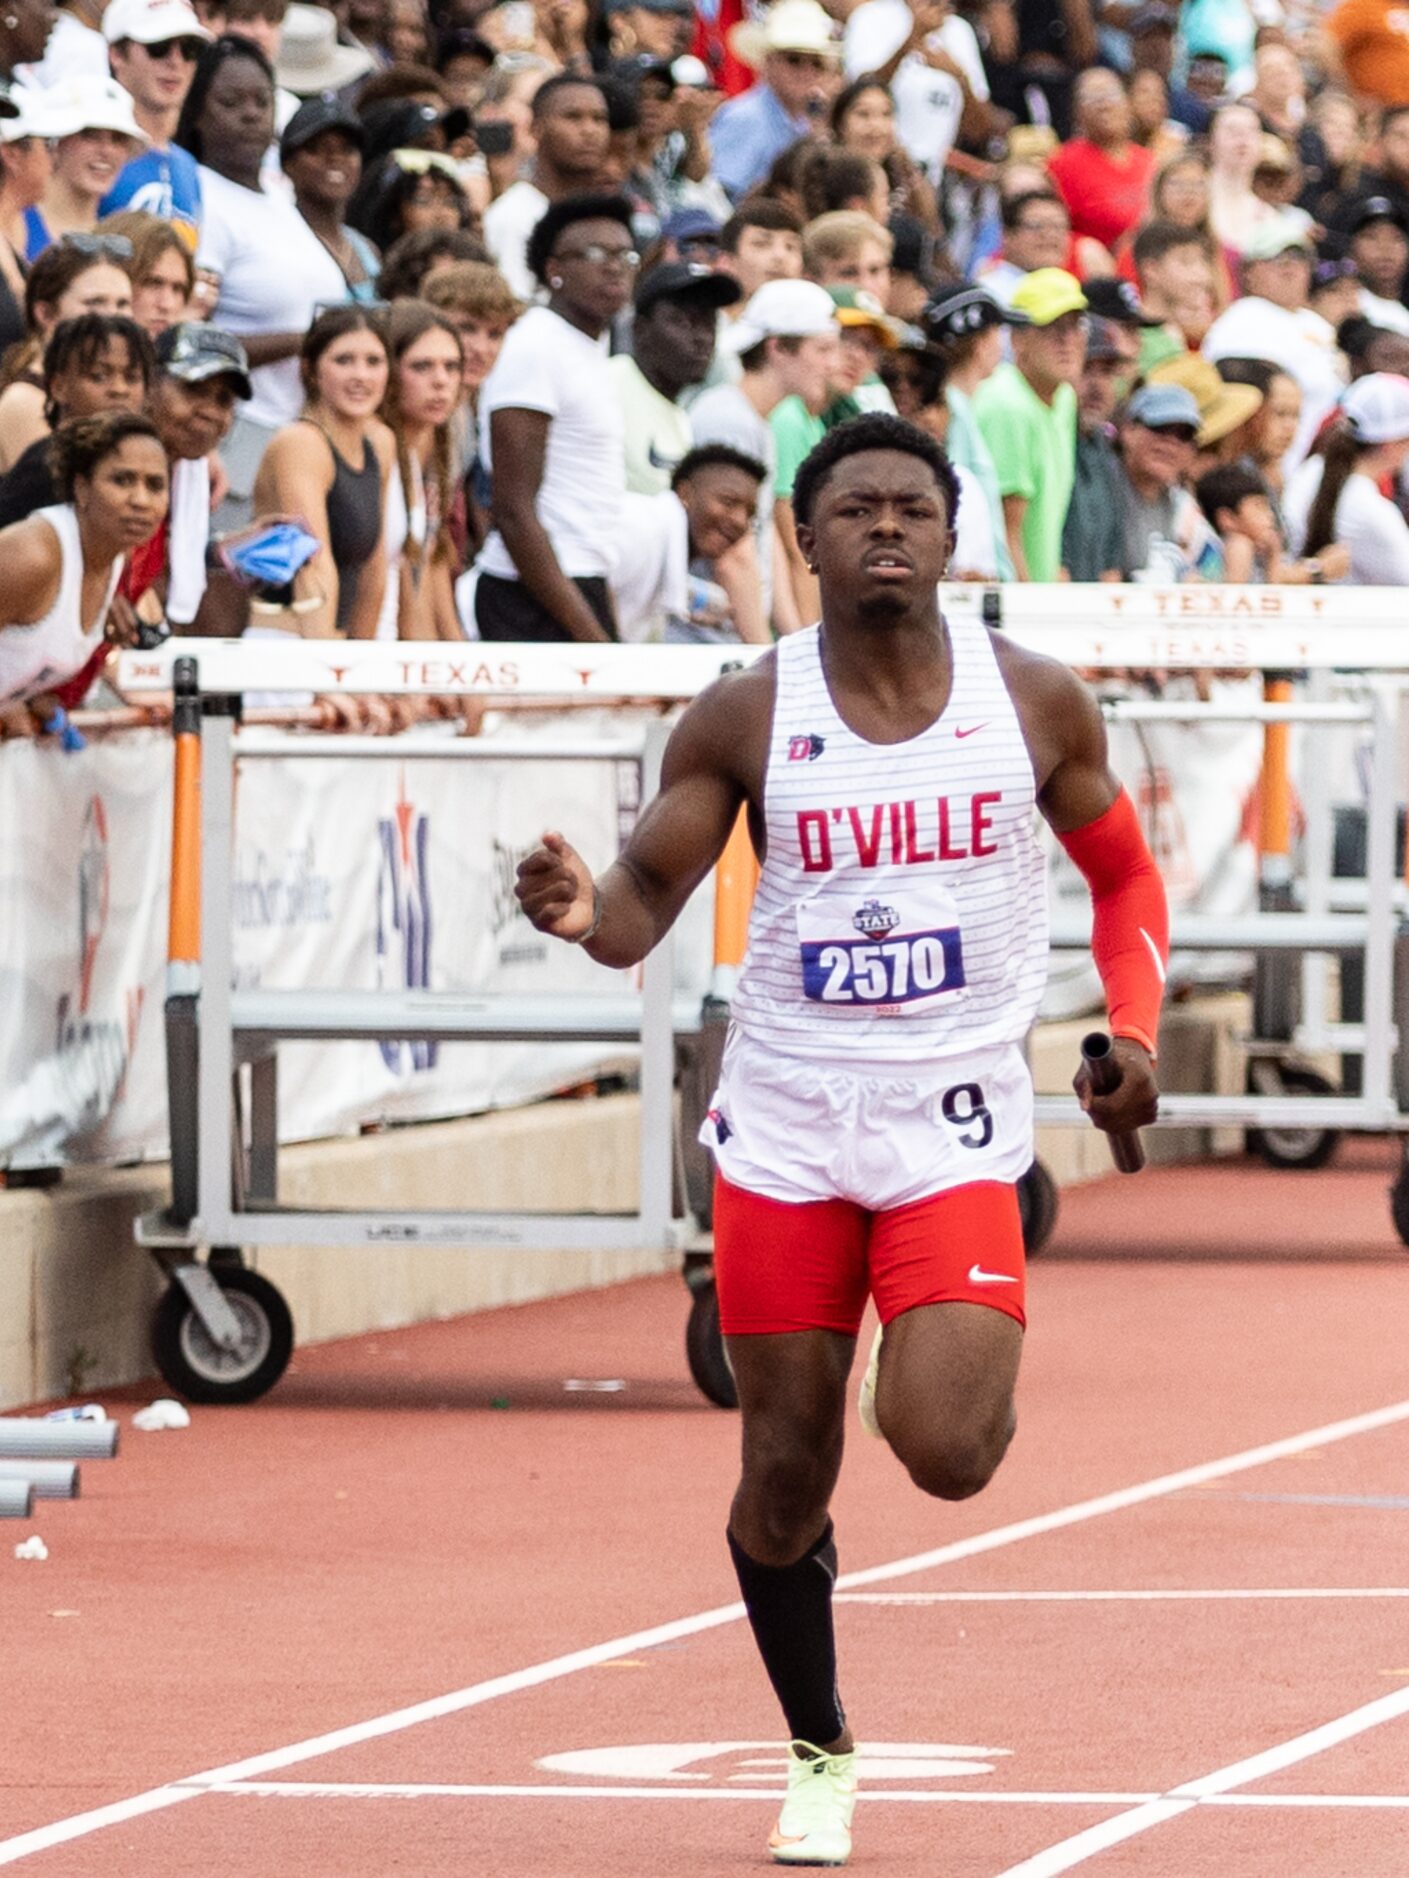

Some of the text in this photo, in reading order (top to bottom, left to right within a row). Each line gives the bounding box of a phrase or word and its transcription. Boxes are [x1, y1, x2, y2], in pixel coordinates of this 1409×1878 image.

[1154, 592, 1283, 618] TEXAS
[397, 661, 520, 685] TEXAS
[796, 790, 1003, 873] D'VILLE
[853, 912, 900, 929] STATE
[819, 937, 945, 1001] 2570
[941, 1082, 993, 1149] 9
